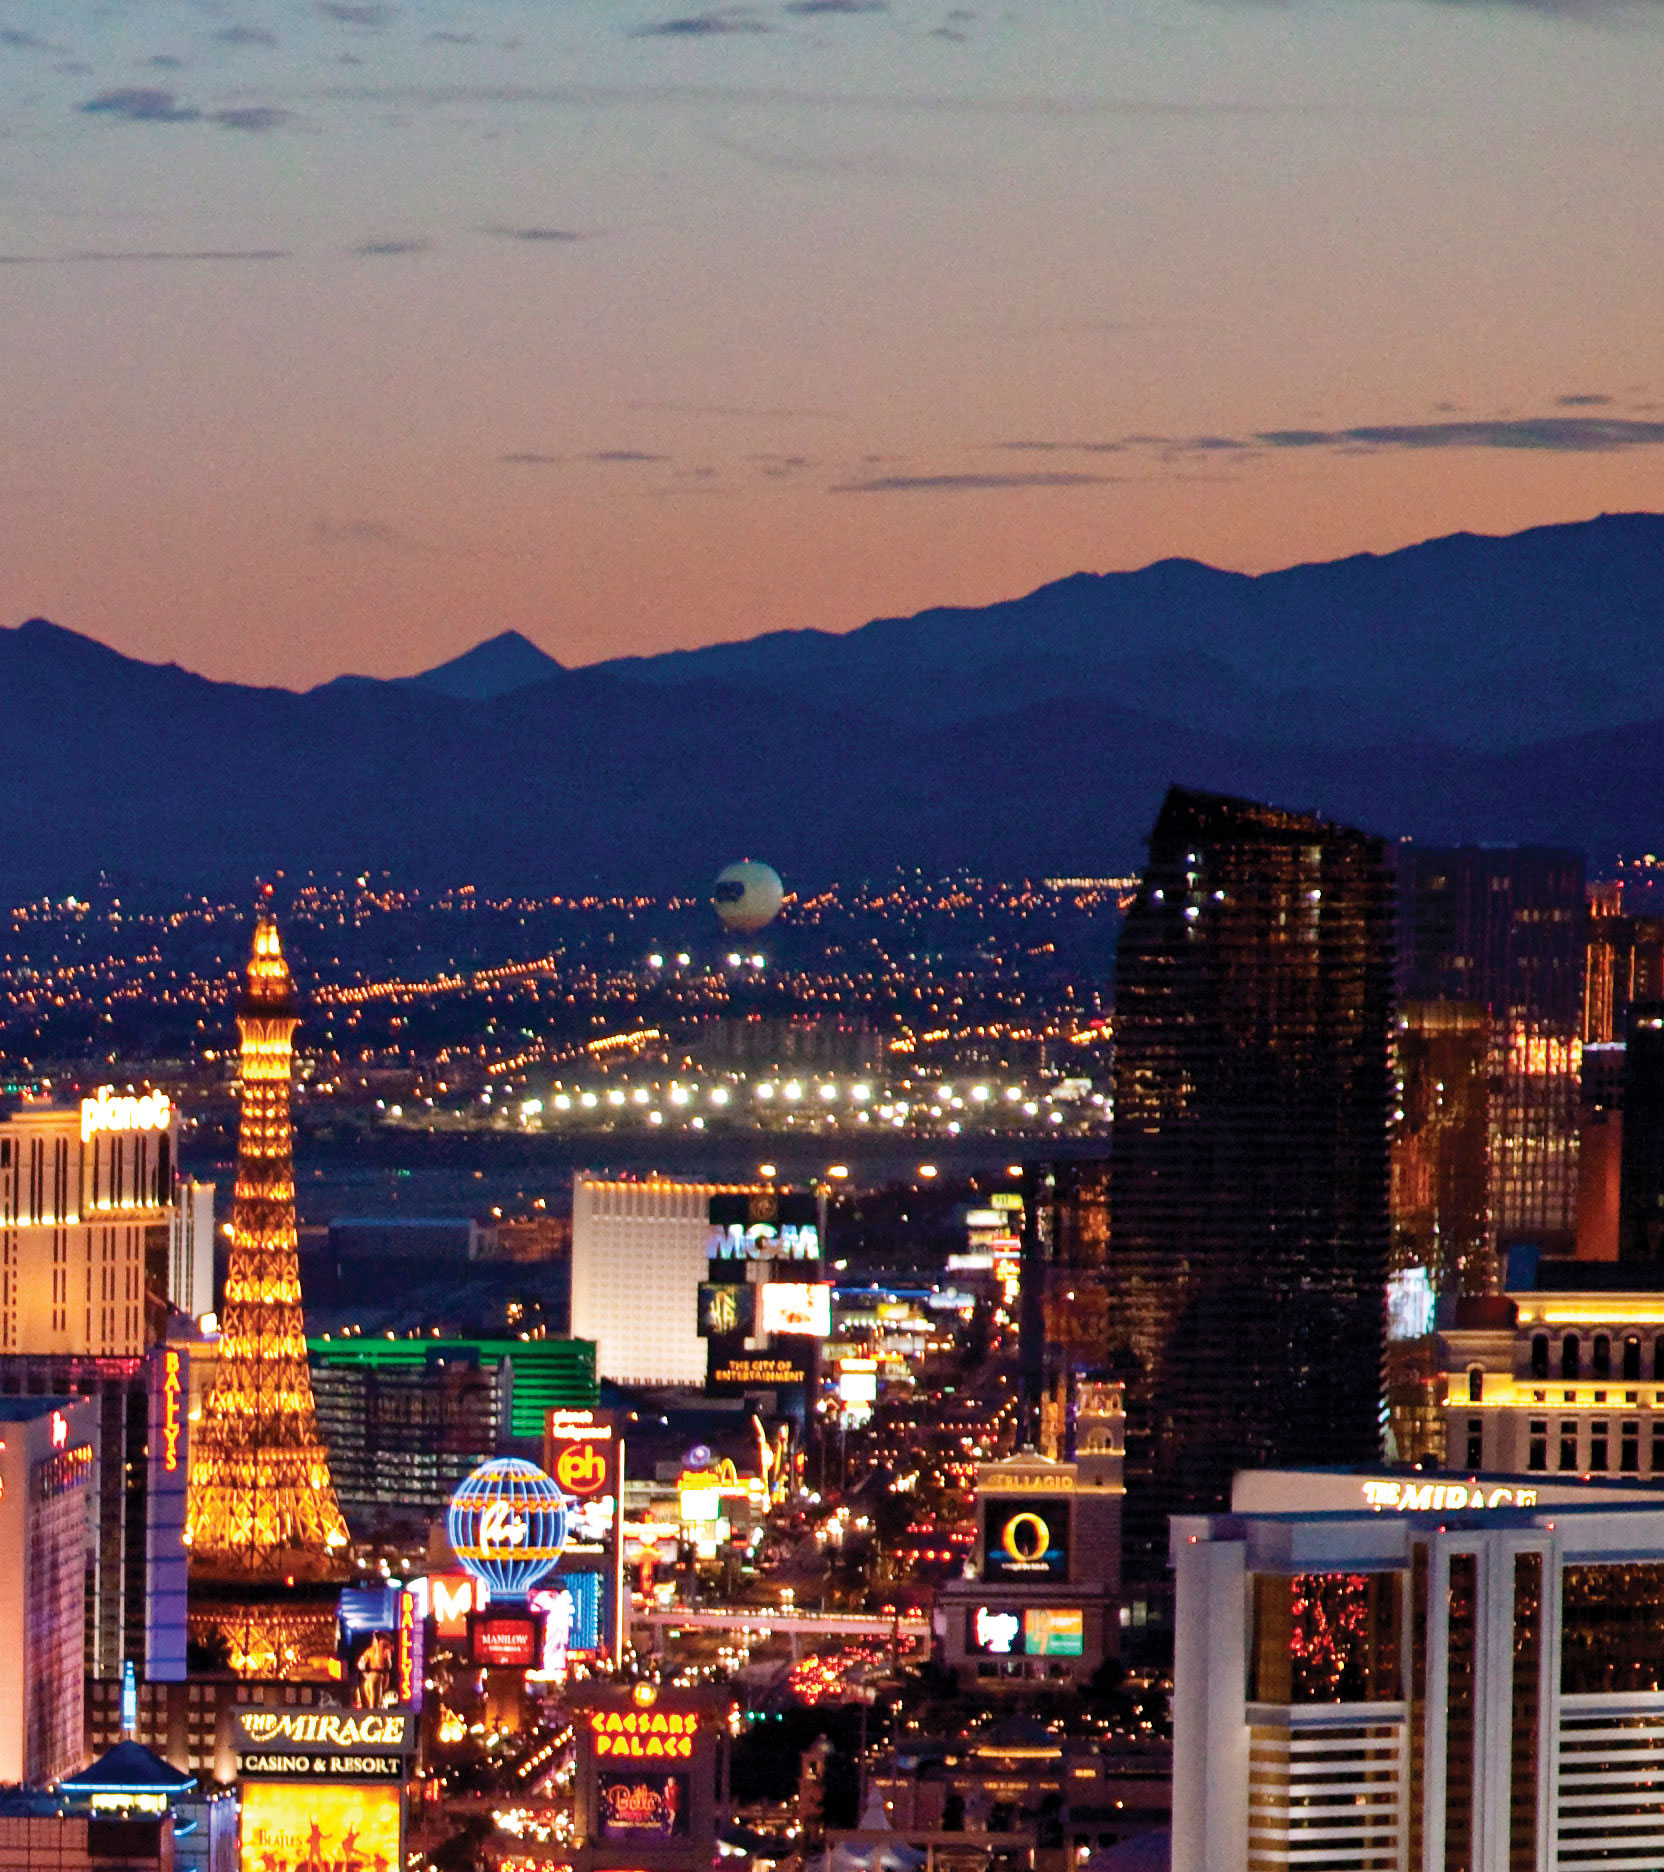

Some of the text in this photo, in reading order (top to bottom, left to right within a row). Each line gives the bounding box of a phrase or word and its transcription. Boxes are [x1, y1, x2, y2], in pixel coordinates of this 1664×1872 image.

[81, 1085, 170, 1143] planet
[705, 1222, 821, 1261] MGM
[715, 1369, 805, 1382] ENTERTAINMENT
[729, 1360, 792, 1371] THE CITY OF
[1001, 1511, 1050, 1562] O
[482, 1633, 528, 1645] MANILOW
[241, 1713, 405, 1746] THE MIRAGE
[591, 1712, 698, 1735] CAESARS
[596, 1735, 692, 1757] PALACE
[245, 1755, 401, 1774] CASINO & RESORT
